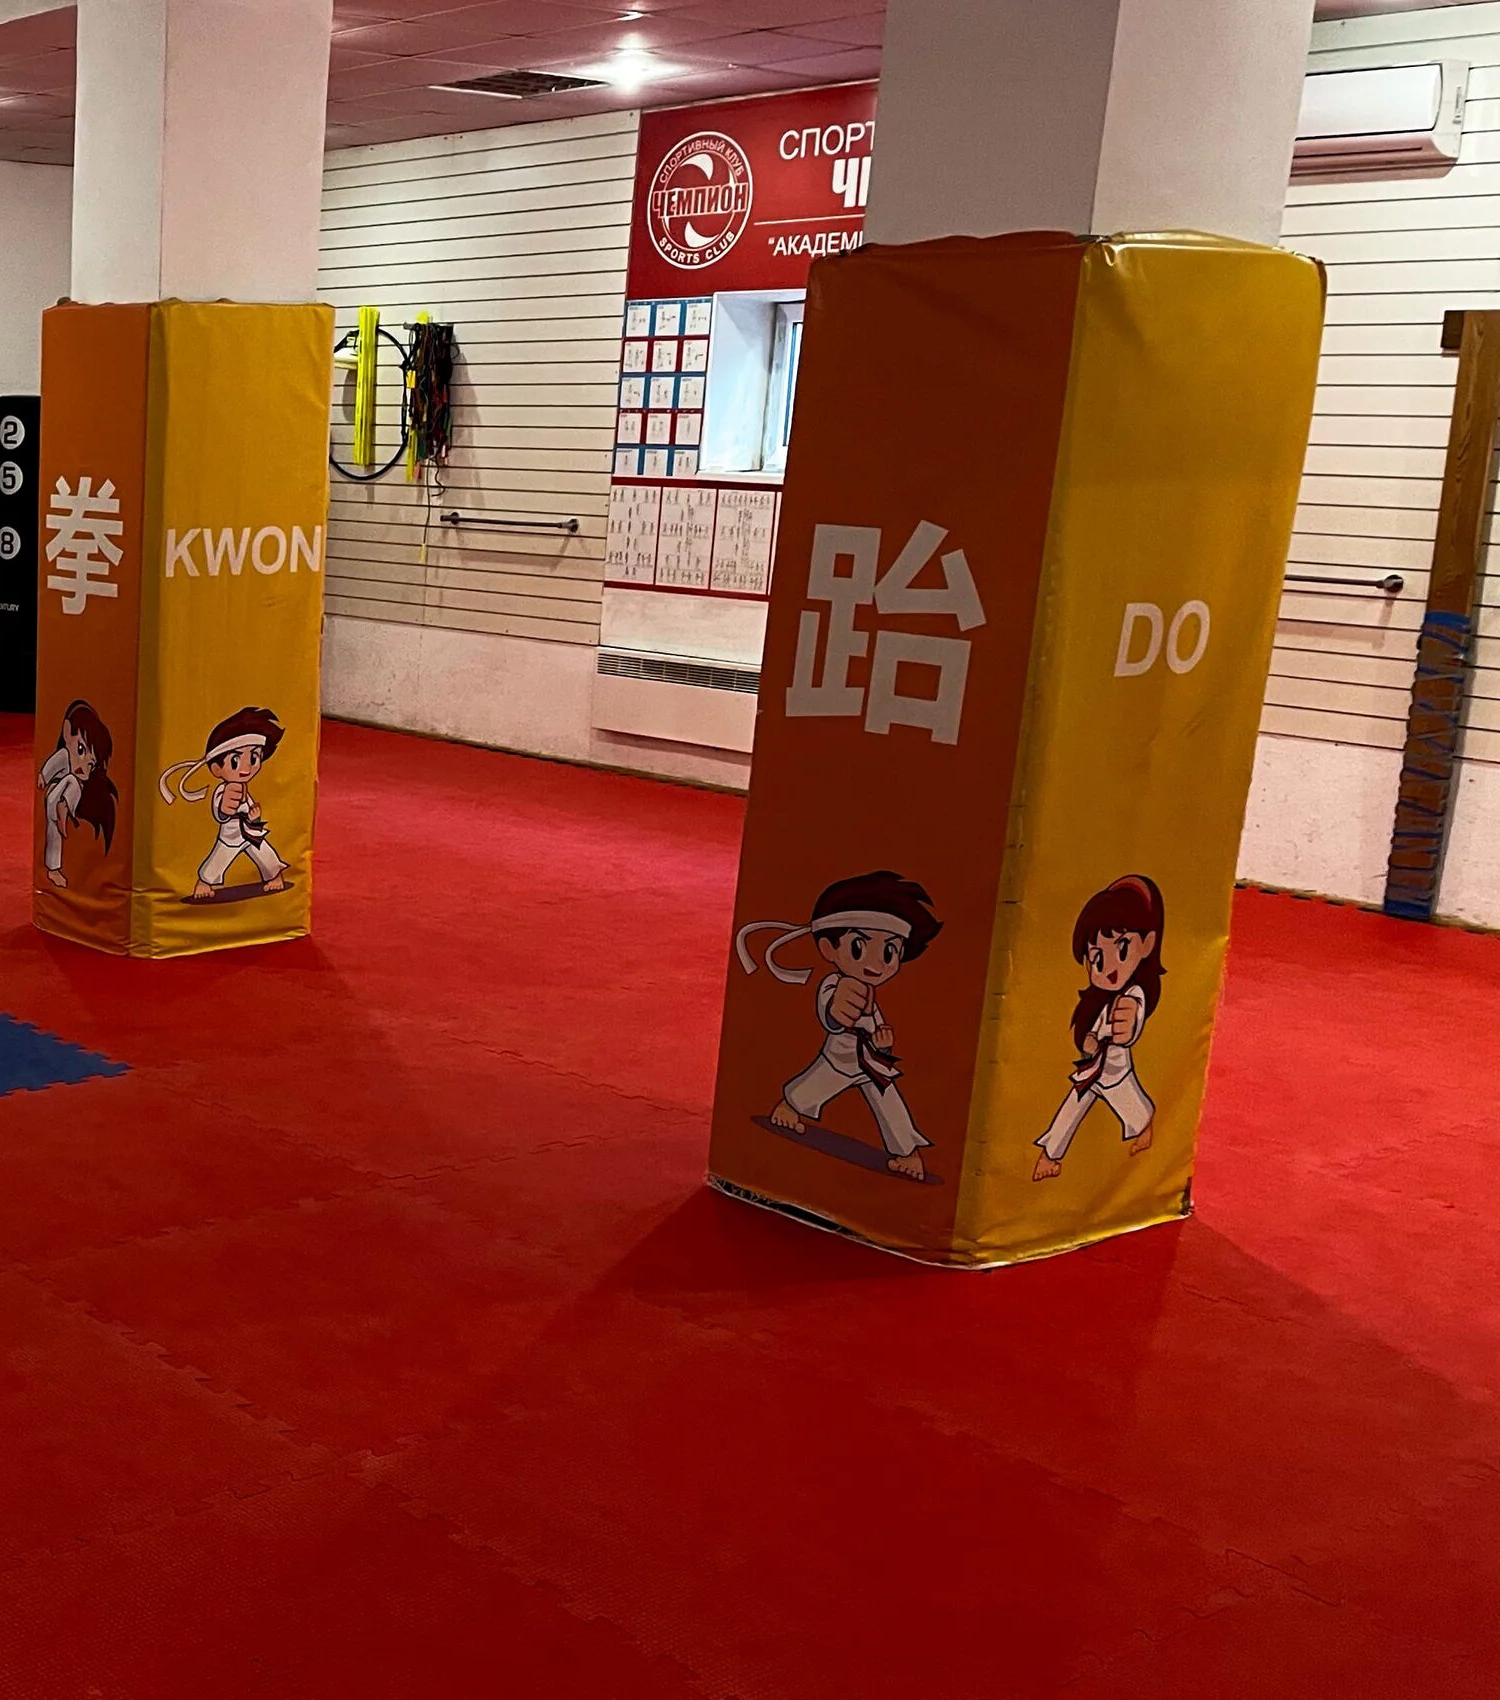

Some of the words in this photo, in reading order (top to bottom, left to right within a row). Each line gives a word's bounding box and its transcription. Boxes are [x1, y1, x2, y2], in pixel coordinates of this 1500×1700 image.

[660, 139, 726, 183] СПОРТИВНЫЙ
[725, 147, 745, 177] КЛУБ
[652, 182, 749, 219] ЧЕМПИОН
[659, 237, 700, 264] SPORTS
[705, 231, 735, 260] CLUB
[3, 421, 18, 444] 2
[2, 466, 16, 489] 5
[1, 531, 15, 554] 8
[45, 476, 123, 614] 拳
[165, 525, 322, 578] KWON
[786, 519, 986, 745] 跆
[1113, 600, 1211, 678] DO
